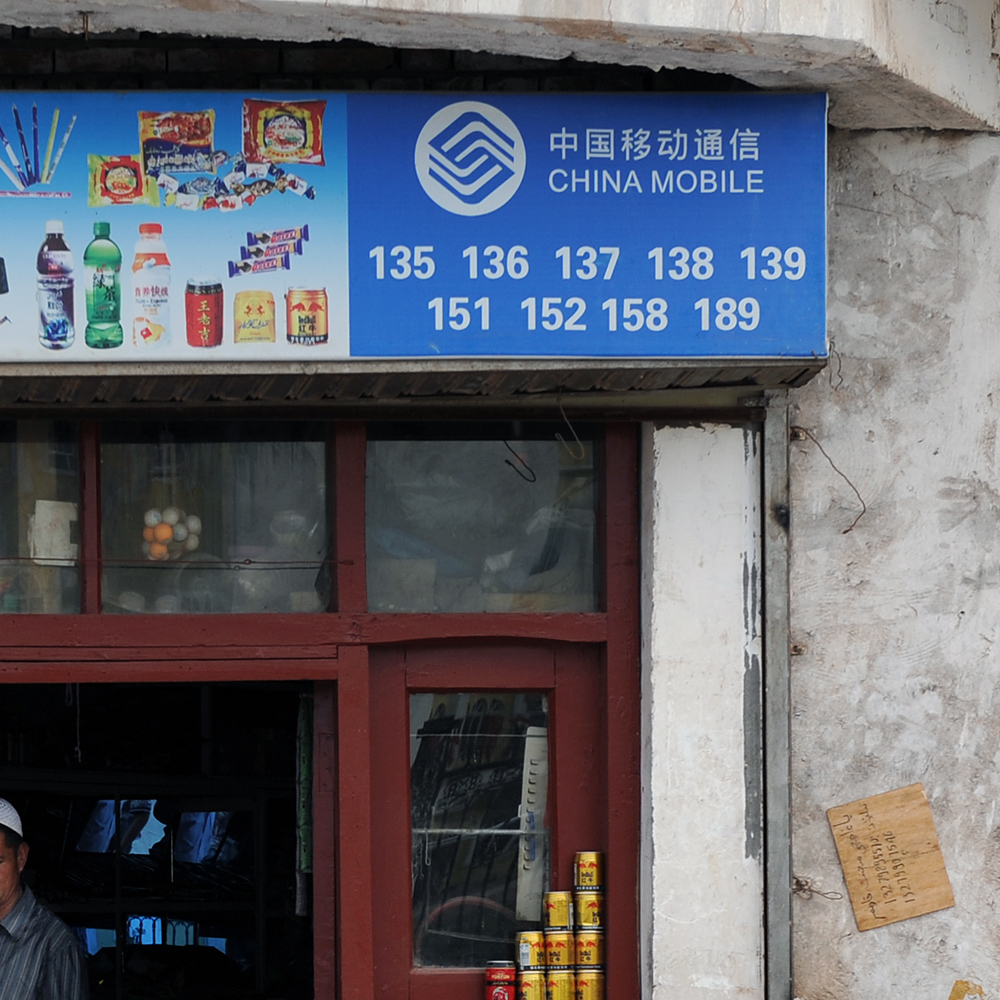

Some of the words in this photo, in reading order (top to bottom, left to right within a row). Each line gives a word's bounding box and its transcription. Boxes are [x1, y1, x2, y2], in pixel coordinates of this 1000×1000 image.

[549, 126, 762, 163] 中国移动通信
[548, 168, 644, 195] CHINA
[651, 168, 766, 195] MOBILE
[369, 245, 436, 281] 135
[462, 245, 530, 281] 136
[555, 245, 621, 281] 137
[647, 246, 715, 281] 138
[740, 246, 807, 282] 139
[197, 300, 212, 343] 王老吉
[428, 297, 491, 331] 151
[520, 297, 588, 331] 152
[601, 297, 669, 332] 158
[694, 297, 761, 331] 189
